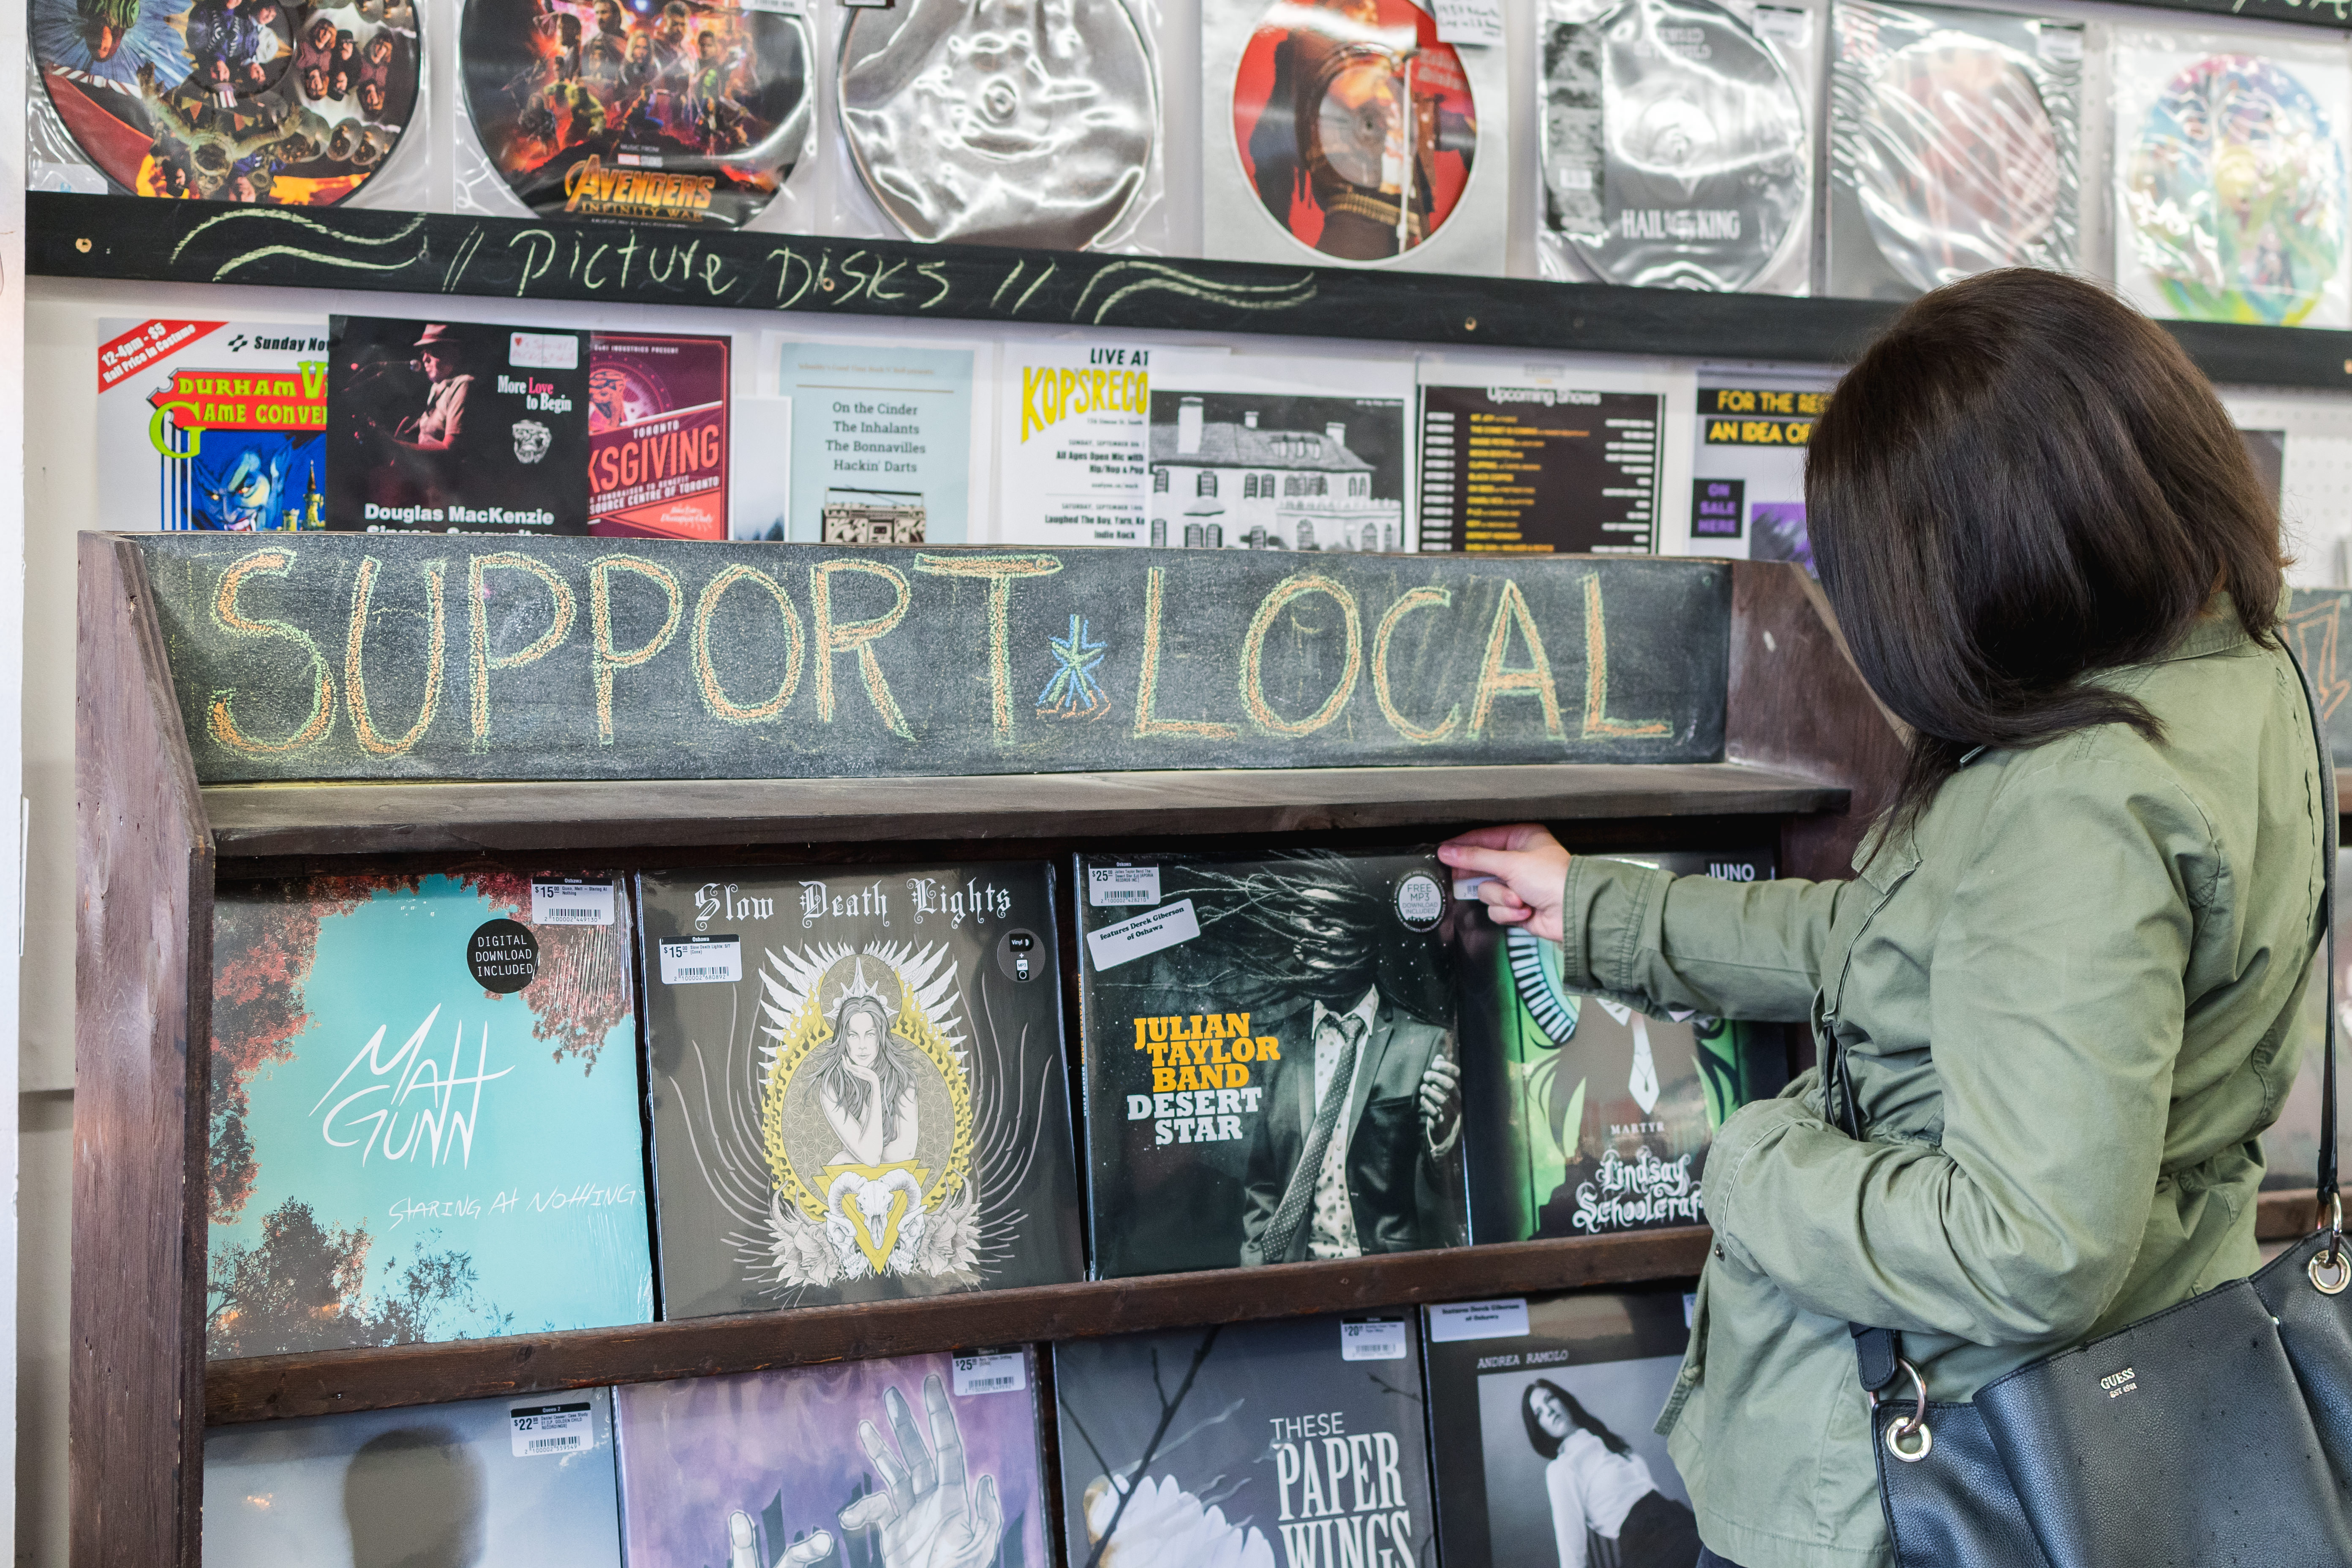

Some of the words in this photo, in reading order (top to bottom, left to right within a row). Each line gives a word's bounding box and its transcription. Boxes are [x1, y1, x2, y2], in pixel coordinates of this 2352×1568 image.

[564, 154, 716, 212] AVENGERS
[583, 201, 661, 217] INFINITY
[1622, 210, 1665, 239] HAIL
[1697, 210, 1741, 240] KING
[147, 322, 166, 340] $5
[121, 352, 147, 372] Price
[155, 324, 196, 352] Costume
[254, 336, 305, 352] Sunday
[1090, 348, 1125, 365] LIVE
[179, 378, 297, 397] DURHAM
[498, 375, 526, 394] More
[529, 377, 553, 395] Love
[526, 395, 539, 410] to
[540, 393, 572, 414] Begin
[1487, 387, 1555, 407] Upcoming
[1557, 389, 1601, 406] Shows
[1718, 390, 1755, 411] FOR
[1760, 392, 1793, 413] THE
[833, 401, 850, 413] On
[854, 403, 874, 414] the
[877, 403, 918, 416] Cinder
[633, 419, 680, 439] TORONTO
[833, 421, 857, 433] The
[860, 422, 920, 435] Inhalants
[1710, 422, 1738, 441] AN
[1742, 422, 1783, 443] IDEA
[825, 440, 849, 452] The
[853, 441, 926, 454] Bonnavilles
[1057, 450, 1066, 460] All
[1090, 452, 1109, 461] Open
[833, 460, 881, 472] Hackin'
[884, 460, 917, 473] Darts
[589, 496, 625, 515] SOURCE
[627, 489, 662, 506] CENTRE
[664, 486, 676, 498] OF
[679, 476, 720, 494] TORONTO
[364, 504, 444, 524] Douglas
[449, 506, 555, 525] MacKenzie
[1045, 514, 1078, 525] Laughed
[1081, 515, 1094, 524] The
[207, 547, 1063, 759] SUPPORT
[1134, 566, 1674, 743] LOCAL
[1706, 863, 1756, 882] JUNO
[1407, 884, 1432, 893] FREE
[1410, 893, 1430, 901] MP3
[694, 882, 775, 931] Slow
[798, 879, 890, 928] Death
[906, 877, 1013, 929] Lights
[1100, 926, 1130, 941] features
[1130, 917, 1152, 931] Derek
[1152, 906, 1185, 922] Giberson
[1127, 932, 1135, 941] of
[1135, 924, 1163, 938] Oshawa
[478, 934, 527, 947] DIGITAL
[475, 949, 532, 962] DOWNLOAD
[477, 963, 534, 977] INCLUDED
[1133, 1013, 1251, 1051] JULIAN
[1146, 1037, 1281, 1067] TAYLOR
[1152, 1063, 1251, 1094] BAND
[1127, 1087, 1263, 1121] DESERT
[322, 1083, 482, 1170] GUNN
[1155, 1115, 1244, 1146] STAR
[1610, 1121, 1665, 1135] MARTYR
[1595, 1145, 1691, 1197] Lindsay
[388, 1195, 481, 1231] STARING
[488, 1187, 519, 1216] AT
[526, 1181, 636, 1212] NOTHING
[1477, 1354, 1521, 1369] ANDREA
[1525, 1349, 1569, 1364] RAMOLO
[2100, 1367, 2135, 1389] GUESS
[1270, 1412, 1344, 1440] THESE
[1273, 1432, 1406, 1522] PAPER
[1278, 1510, 1416, 1568] WINGS
